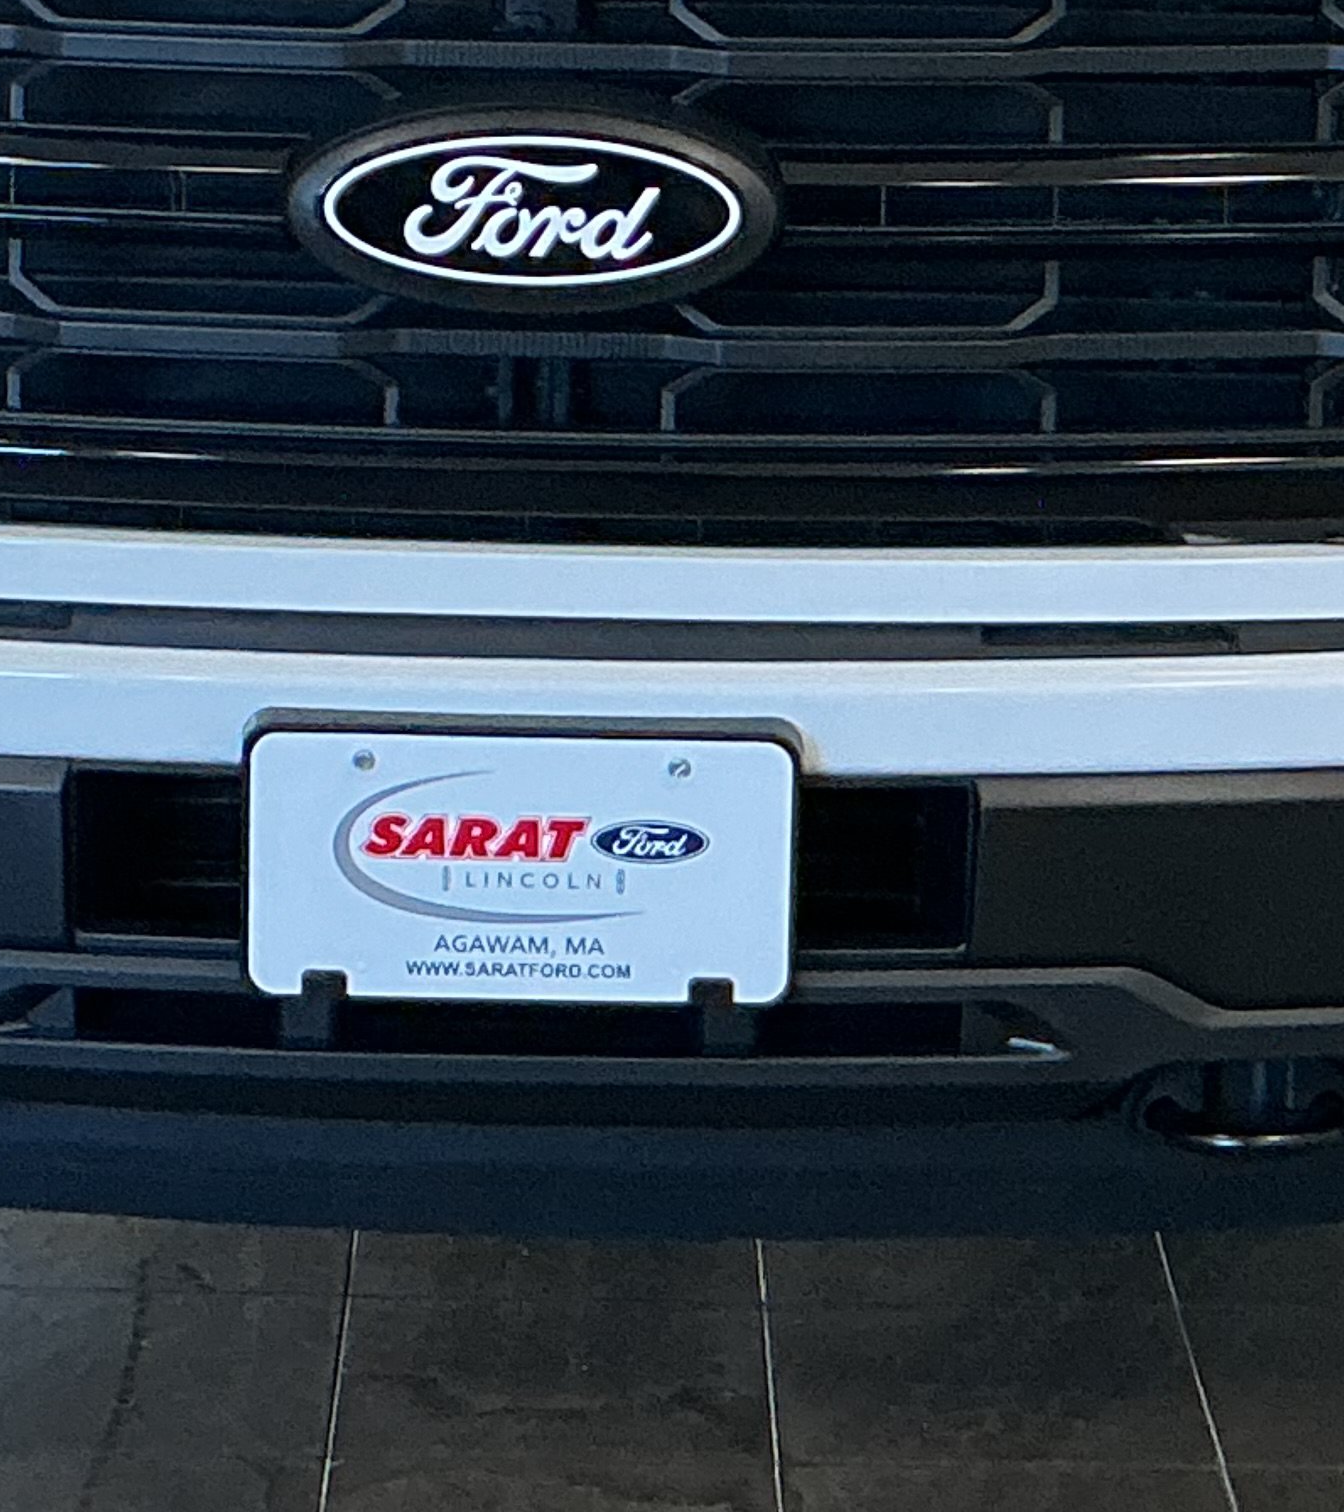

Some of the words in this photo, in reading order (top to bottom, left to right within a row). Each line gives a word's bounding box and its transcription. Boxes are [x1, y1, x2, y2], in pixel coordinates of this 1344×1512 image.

[403, 155, 661, 260] Ford
[361, 812, 590, 861] SARAT
[612, 825, 688, 858] Ford
[464, 870, 604, 890] LINCOLN
[432, 934, 556, 958] AGAWAM,
[565, 937, 605, 956] MA
[405, 960, 632, 980] WWW.SARATFORD.COM
